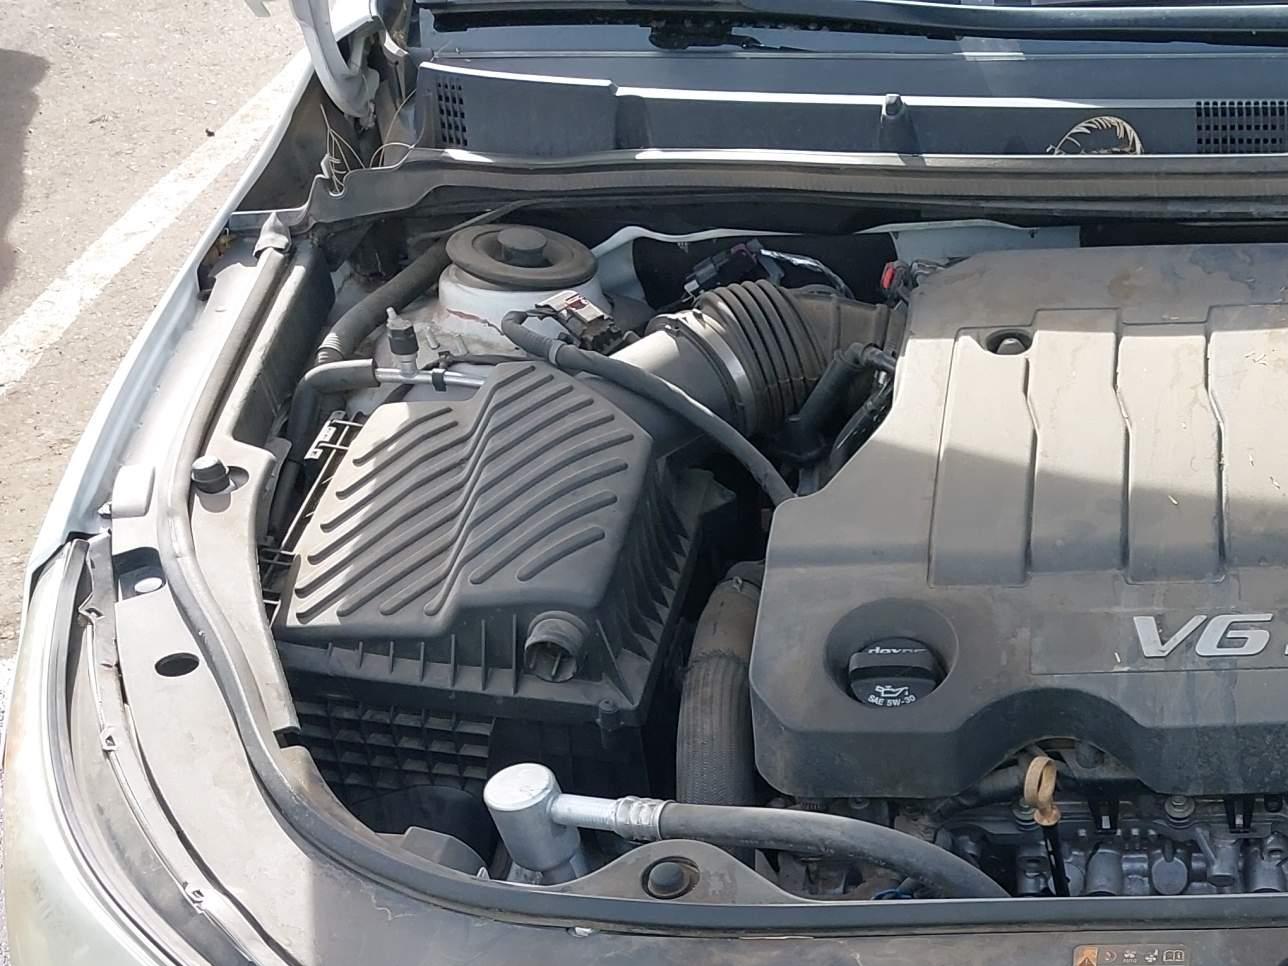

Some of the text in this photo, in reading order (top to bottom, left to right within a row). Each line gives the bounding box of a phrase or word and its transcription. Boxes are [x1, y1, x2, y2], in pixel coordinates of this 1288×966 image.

[1133, 613, 1273, 658] V6
[867, 694, 916, 707] SAE 5W-30
